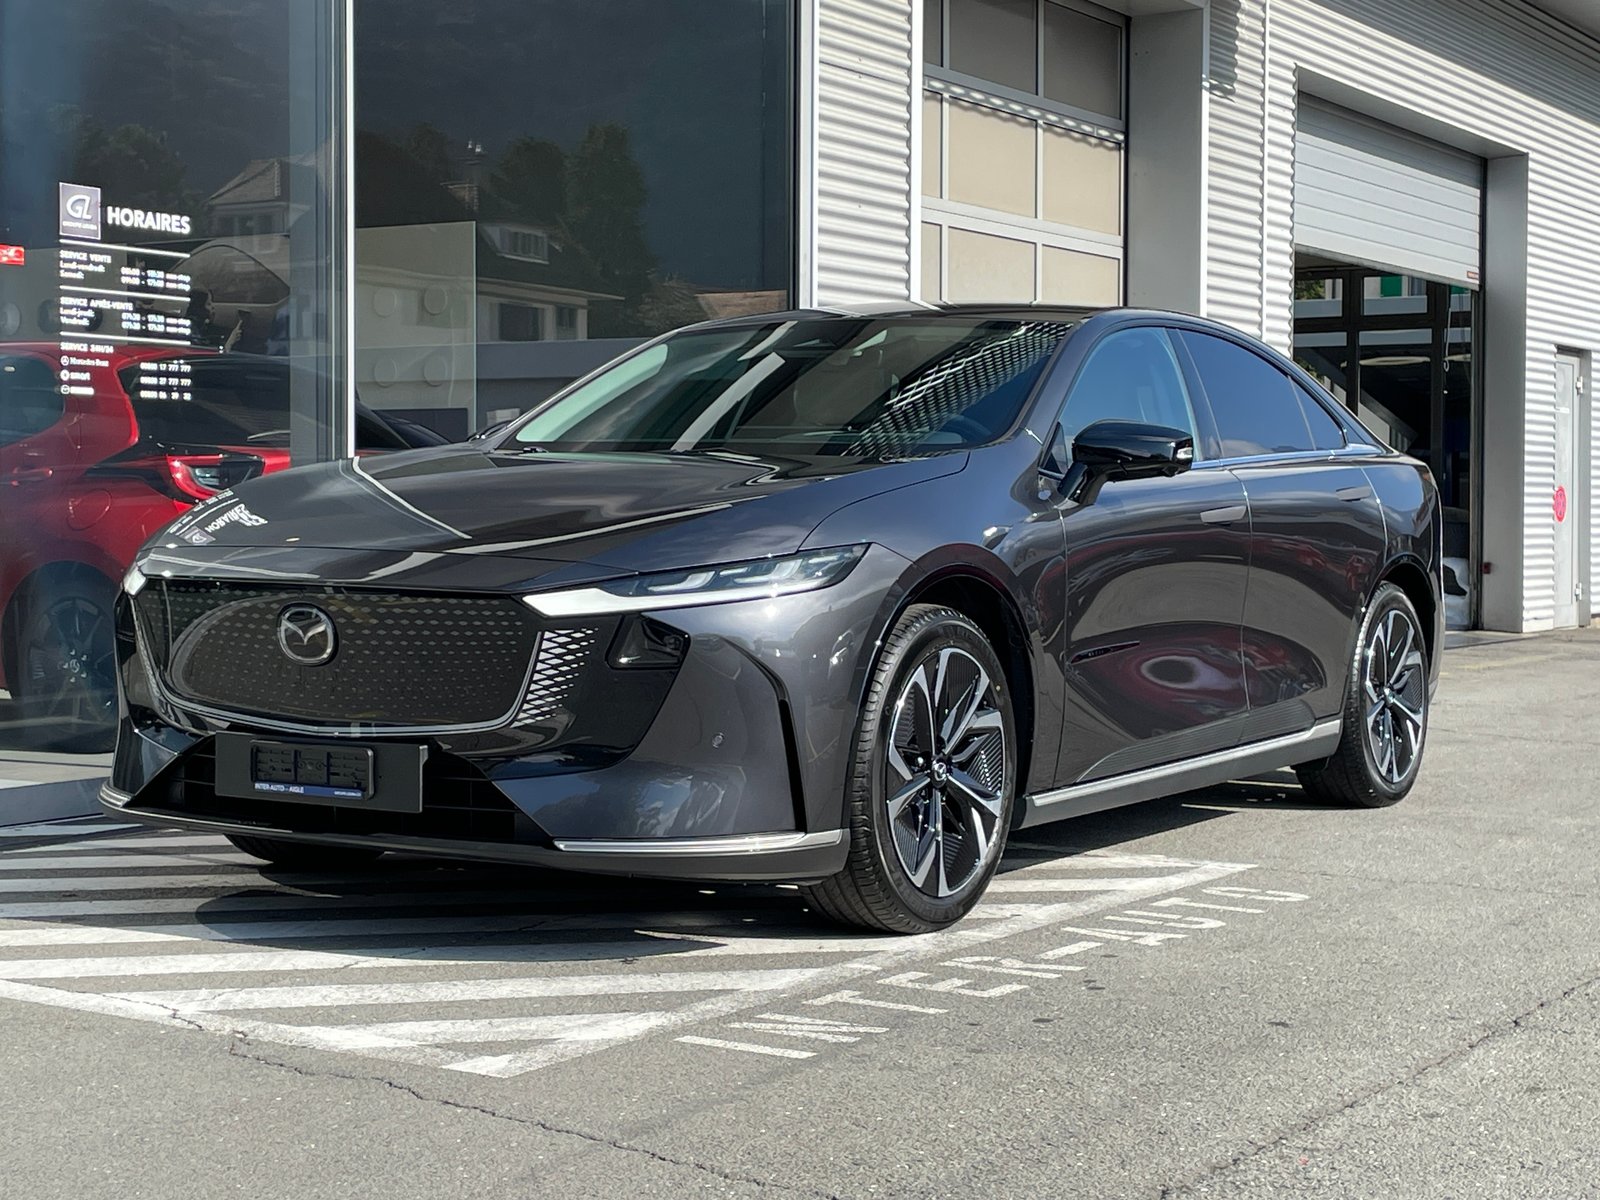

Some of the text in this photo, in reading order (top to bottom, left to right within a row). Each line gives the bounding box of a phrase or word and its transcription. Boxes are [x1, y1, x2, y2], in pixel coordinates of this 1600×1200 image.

[66, 195, 92, 219] GL
[107, 206, 191, 234] HORAIRES
[60, 250, 111, 263] SERVICE VENTE
[60, 296, 88, 306] SERVICE
[60, 342, 88, 351] SERVICE
[70, 357, 109, 367] Mercedes-Benz
